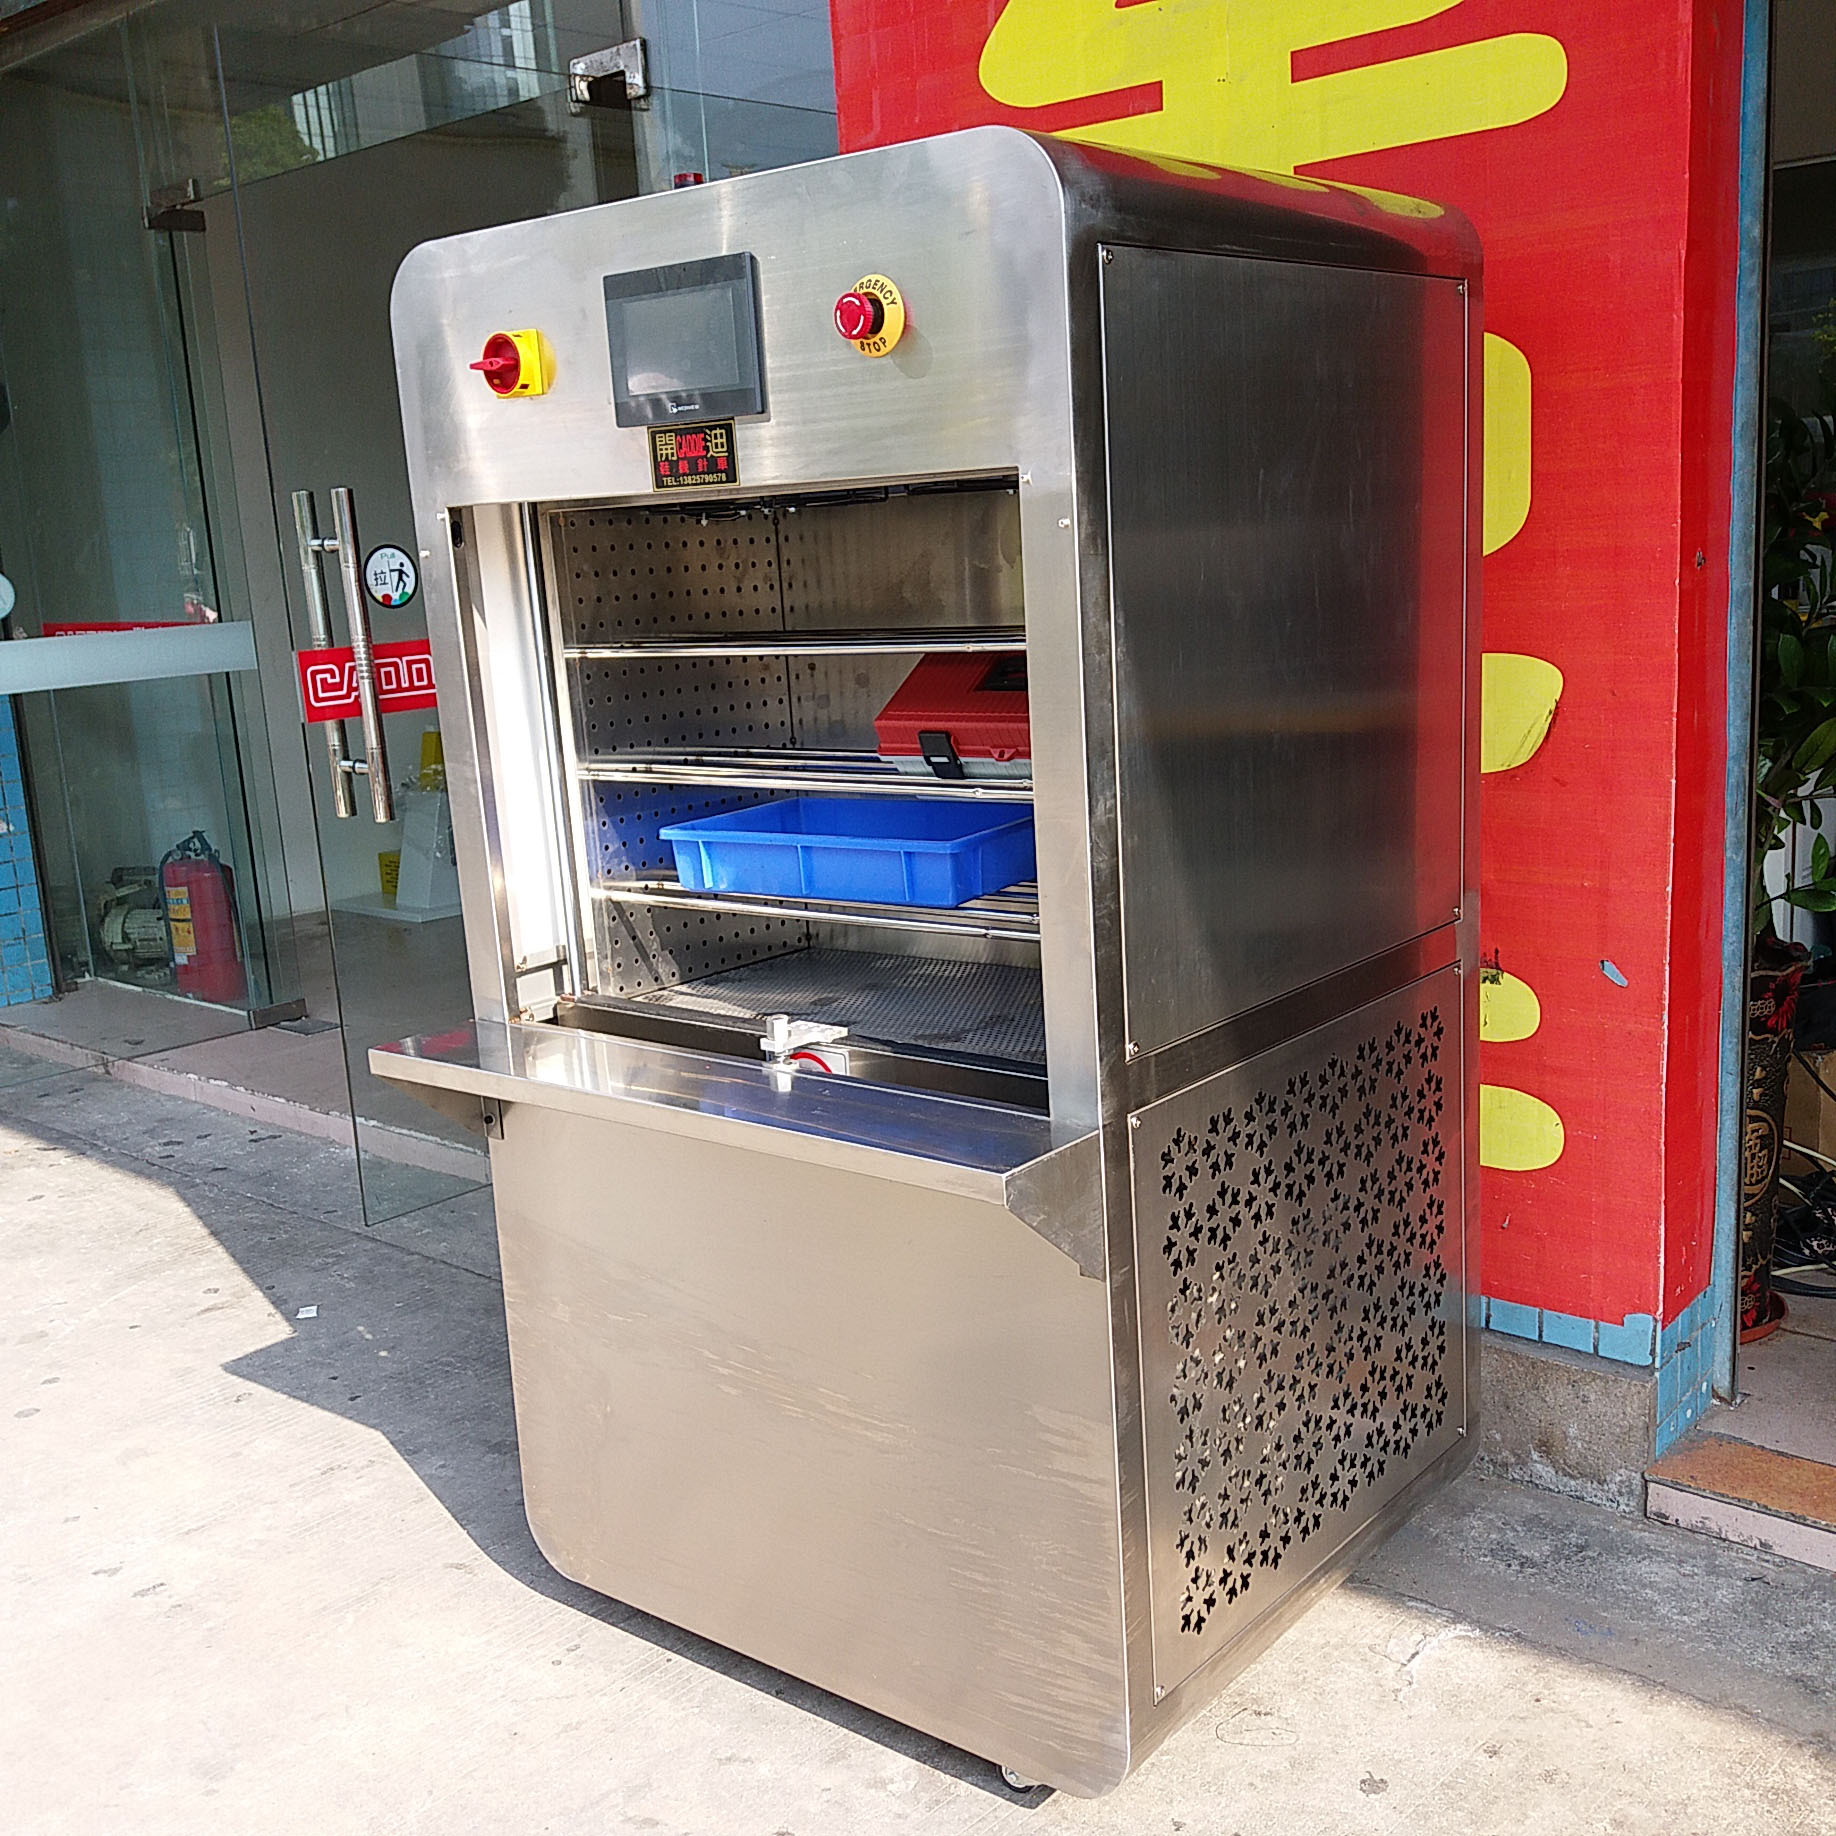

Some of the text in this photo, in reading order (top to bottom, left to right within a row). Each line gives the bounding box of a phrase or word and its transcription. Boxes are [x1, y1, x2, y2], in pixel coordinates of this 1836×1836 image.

[860, 337, 887, 354] STOP
[656, 428, 728, 461] 開 CADDIE 迪
[374, 569, 389, 587] 拉
